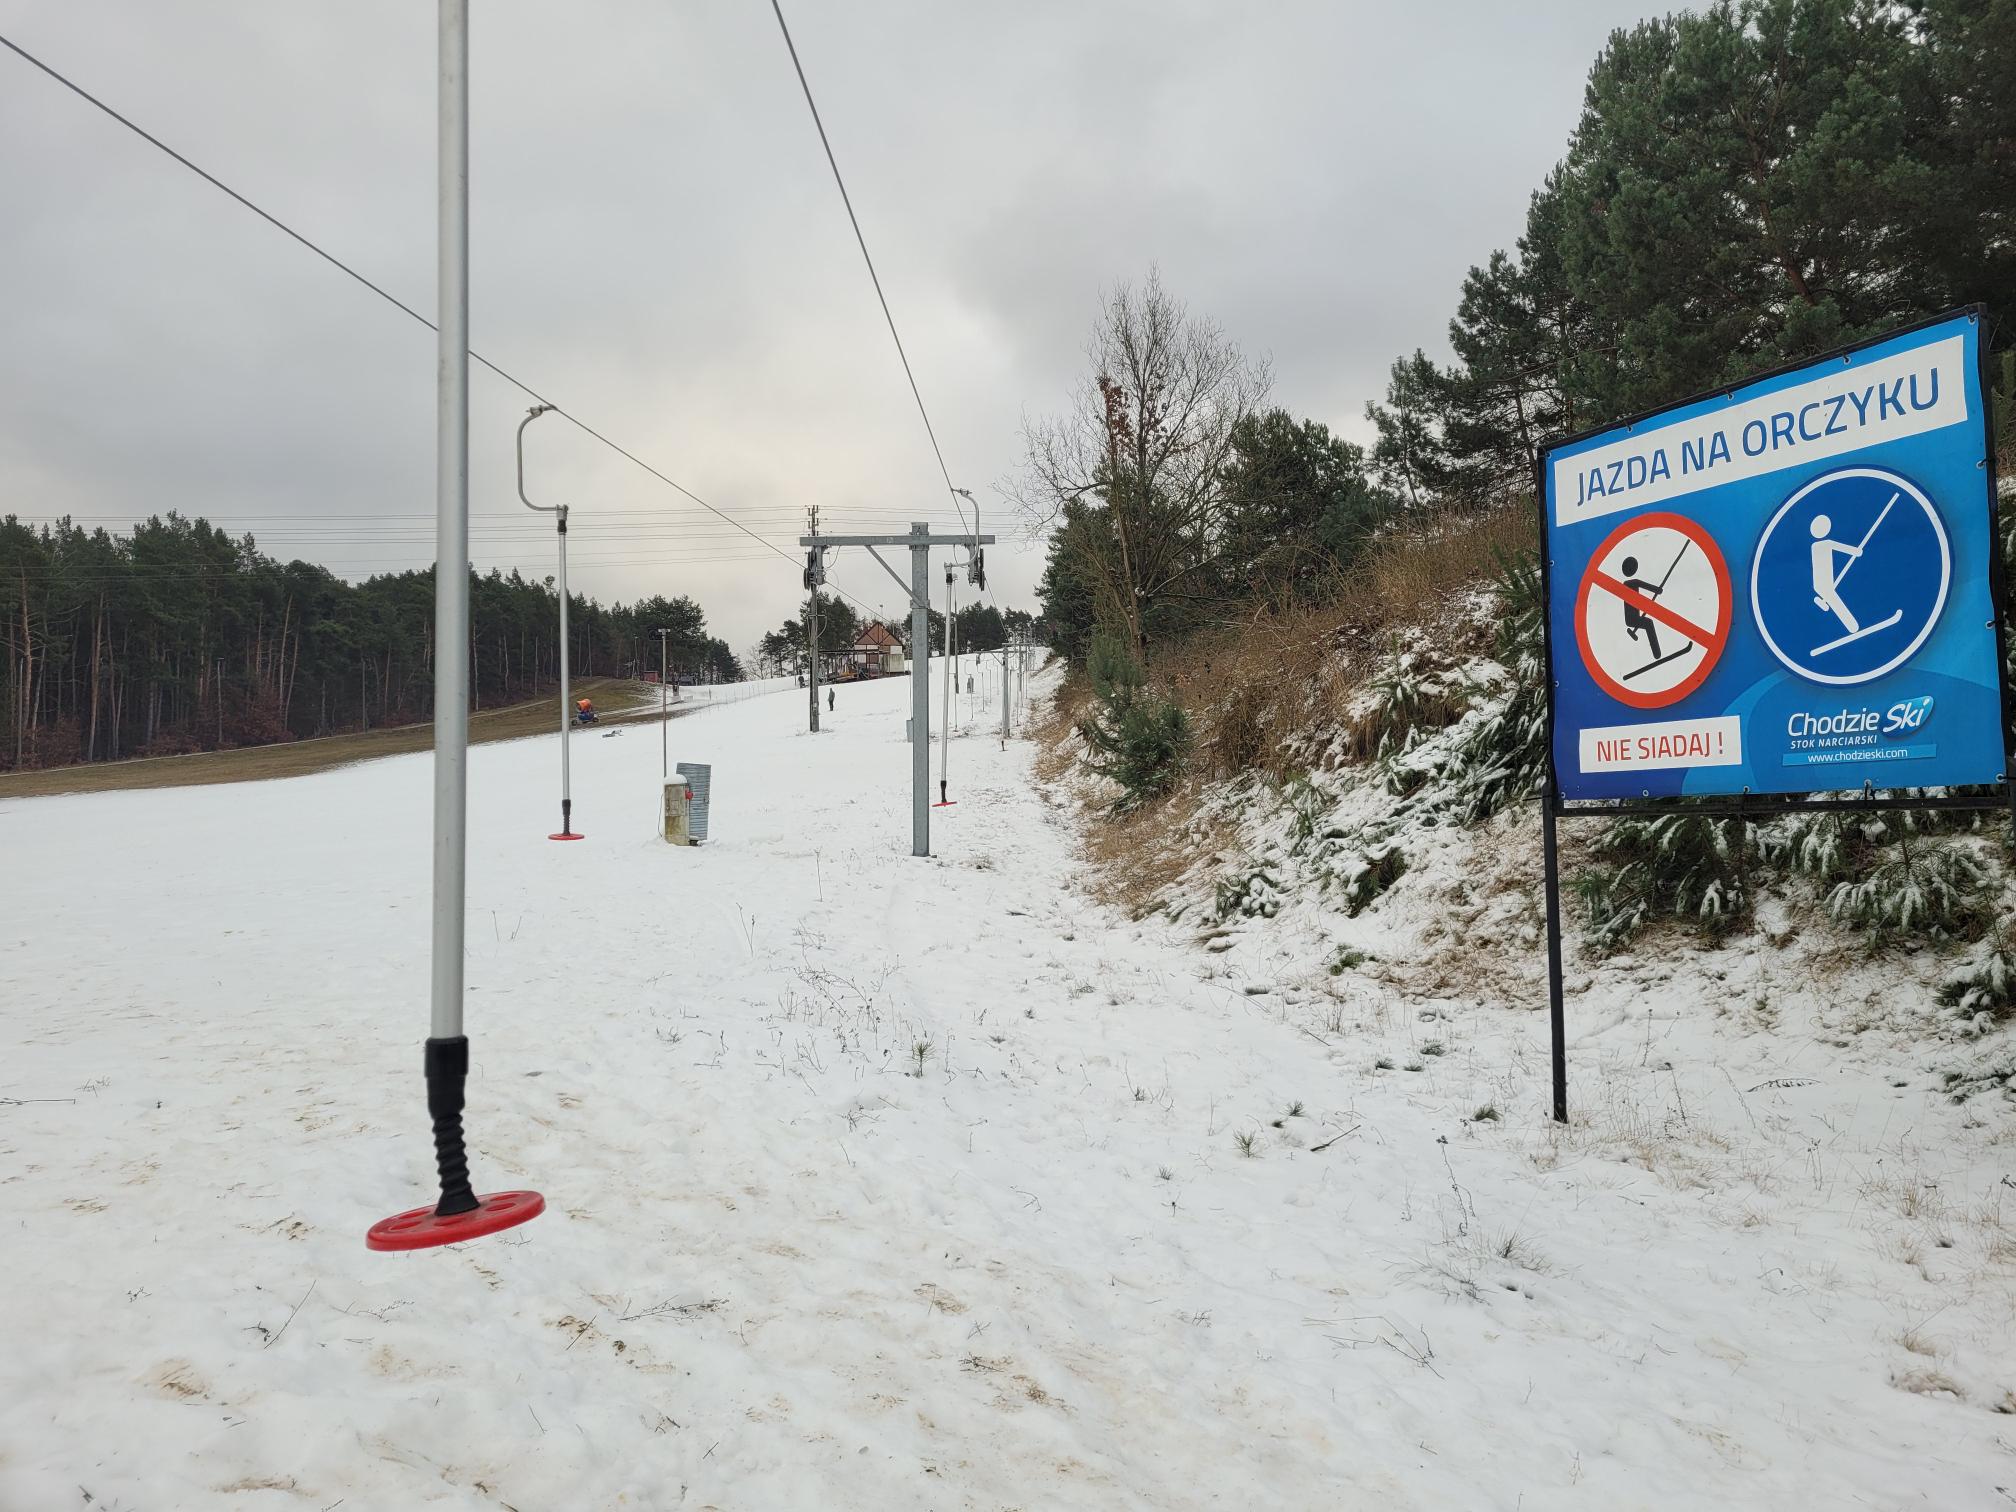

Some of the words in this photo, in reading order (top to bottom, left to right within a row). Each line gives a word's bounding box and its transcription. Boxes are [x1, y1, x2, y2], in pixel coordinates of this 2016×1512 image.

[1577, 448, 1671, 506] JAZDA
[1681, 431, 1732, 475] NA
[1742, 367, 1940, 456] ORCZYKU
[1788, 708, 1880, 736] Chodzie
[1883, 698, 1931, 733] Ski
[1597, 738, 1631, 762] NIE
[1638, 732, 1710, 760] SIADAJ
[1718, 731, 1723, 755] !
[1790, 739, 1815, 750] STOK
[1818, 734, 1878, 748] NARCIARSKI
[1807, 748, 1908, 763] www.chodzieski.com
